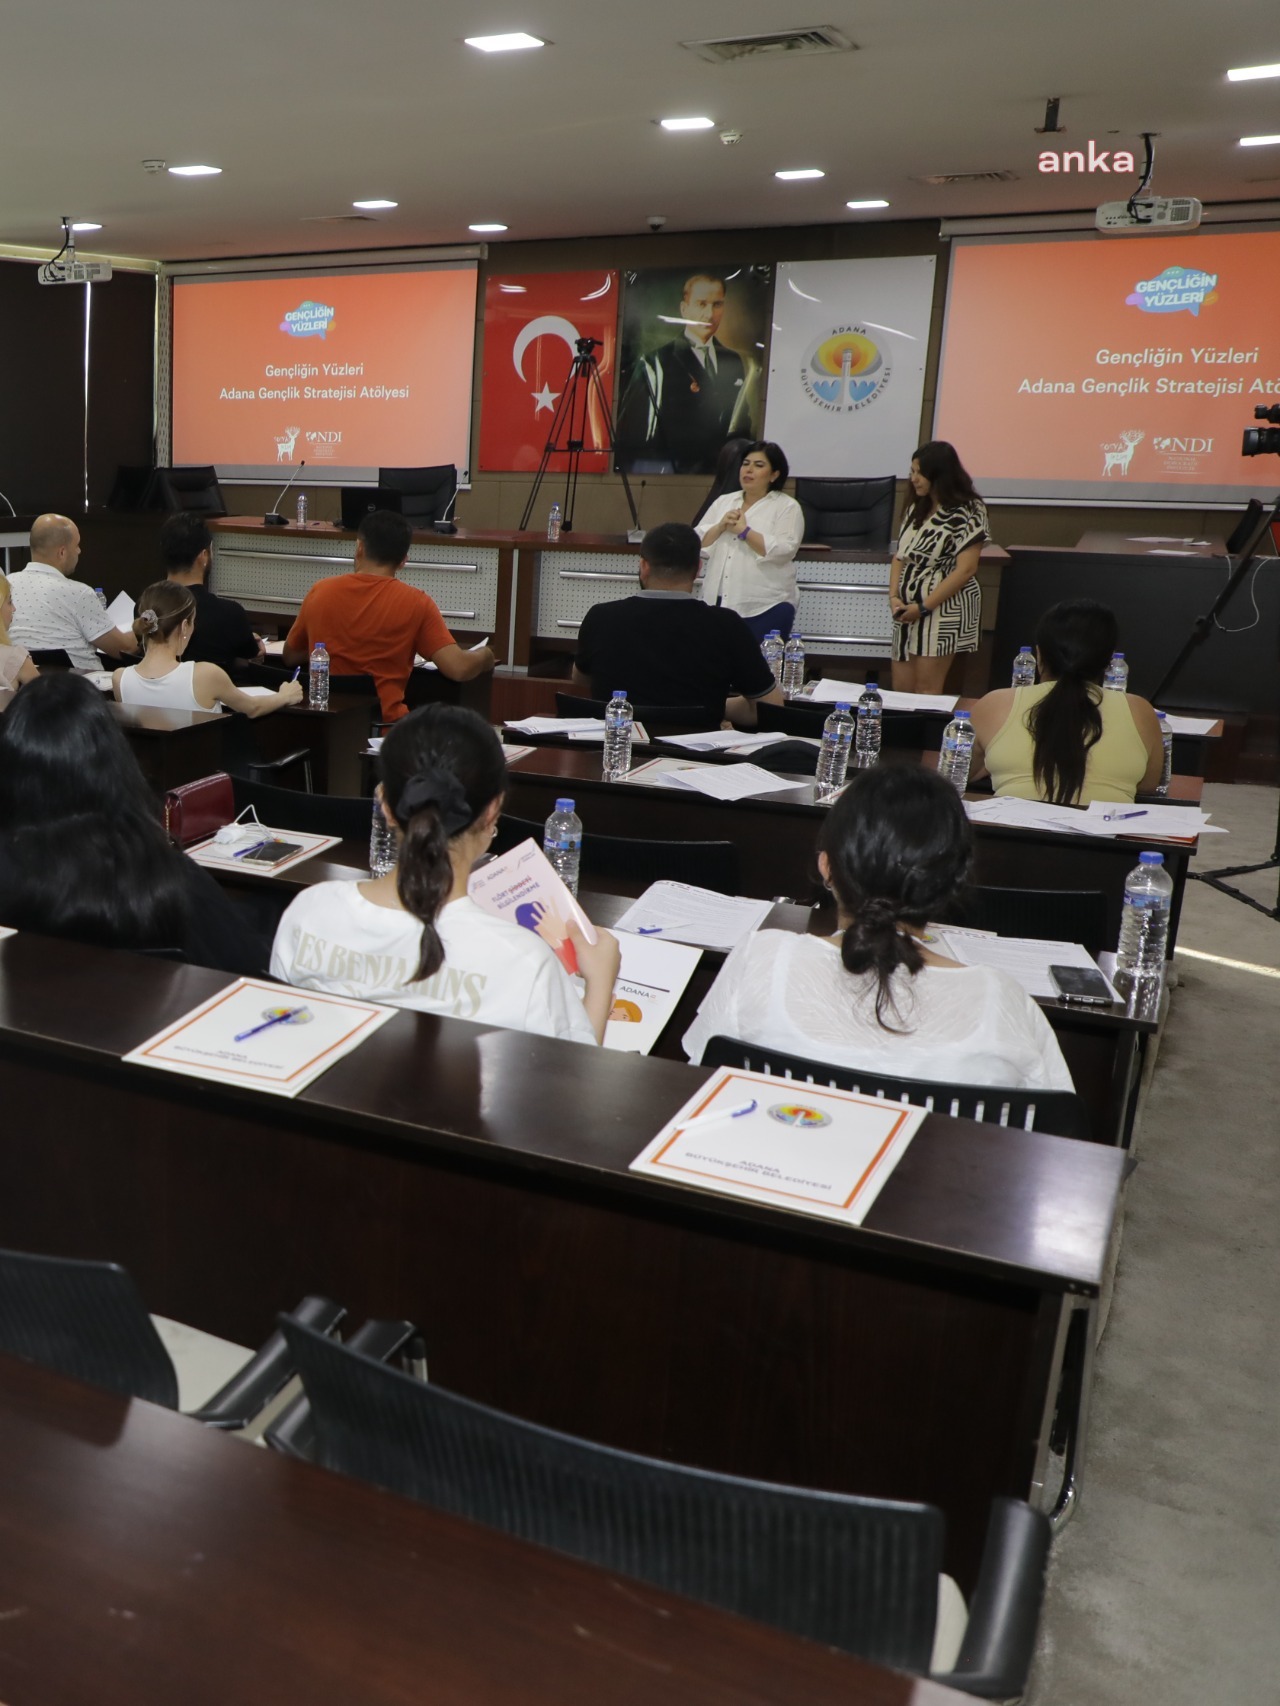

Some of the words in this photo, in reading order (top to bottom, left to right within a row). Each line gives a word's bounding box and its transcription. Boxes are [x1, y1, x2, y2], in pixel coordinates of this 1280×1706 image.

[1135, 273, 1217, 294] GENÇLİĞİN
[1145, 289, 1205, 307] YÜZLERİ
[285, 306, 334, 322] GENÇLİĞİN
[291, 319, 327, 333] YÜZLERİ
[832, 326, 866, 335] ADANA
[1096, 348, 1183, 368] Gençliğin
[1190, 348, 1260, 364] Yüzleri
[266, 363, 318, 379] Gençliğin
[322, 362, 364, 376] Yüzleri
[220, 387, 255, 400] Adana
[259, 386, 300, 401] Gençlik
[304, 385, 357, 401] Stratejisi
[360, 385, 409, 401] Atölyesi
[801, 368, 842, 411] BÜYÜKŞEHİR
[1018, 378, 1075, 394] Adana
[1082, 378, 1150, 397] Gençlik
[1156, 377, 1244, 398] Stratejisi
[317, 431, 342, 442] NDI
[1170, 437, 1214, 453] NDI
[619, 986, 650, 998] ADANA
